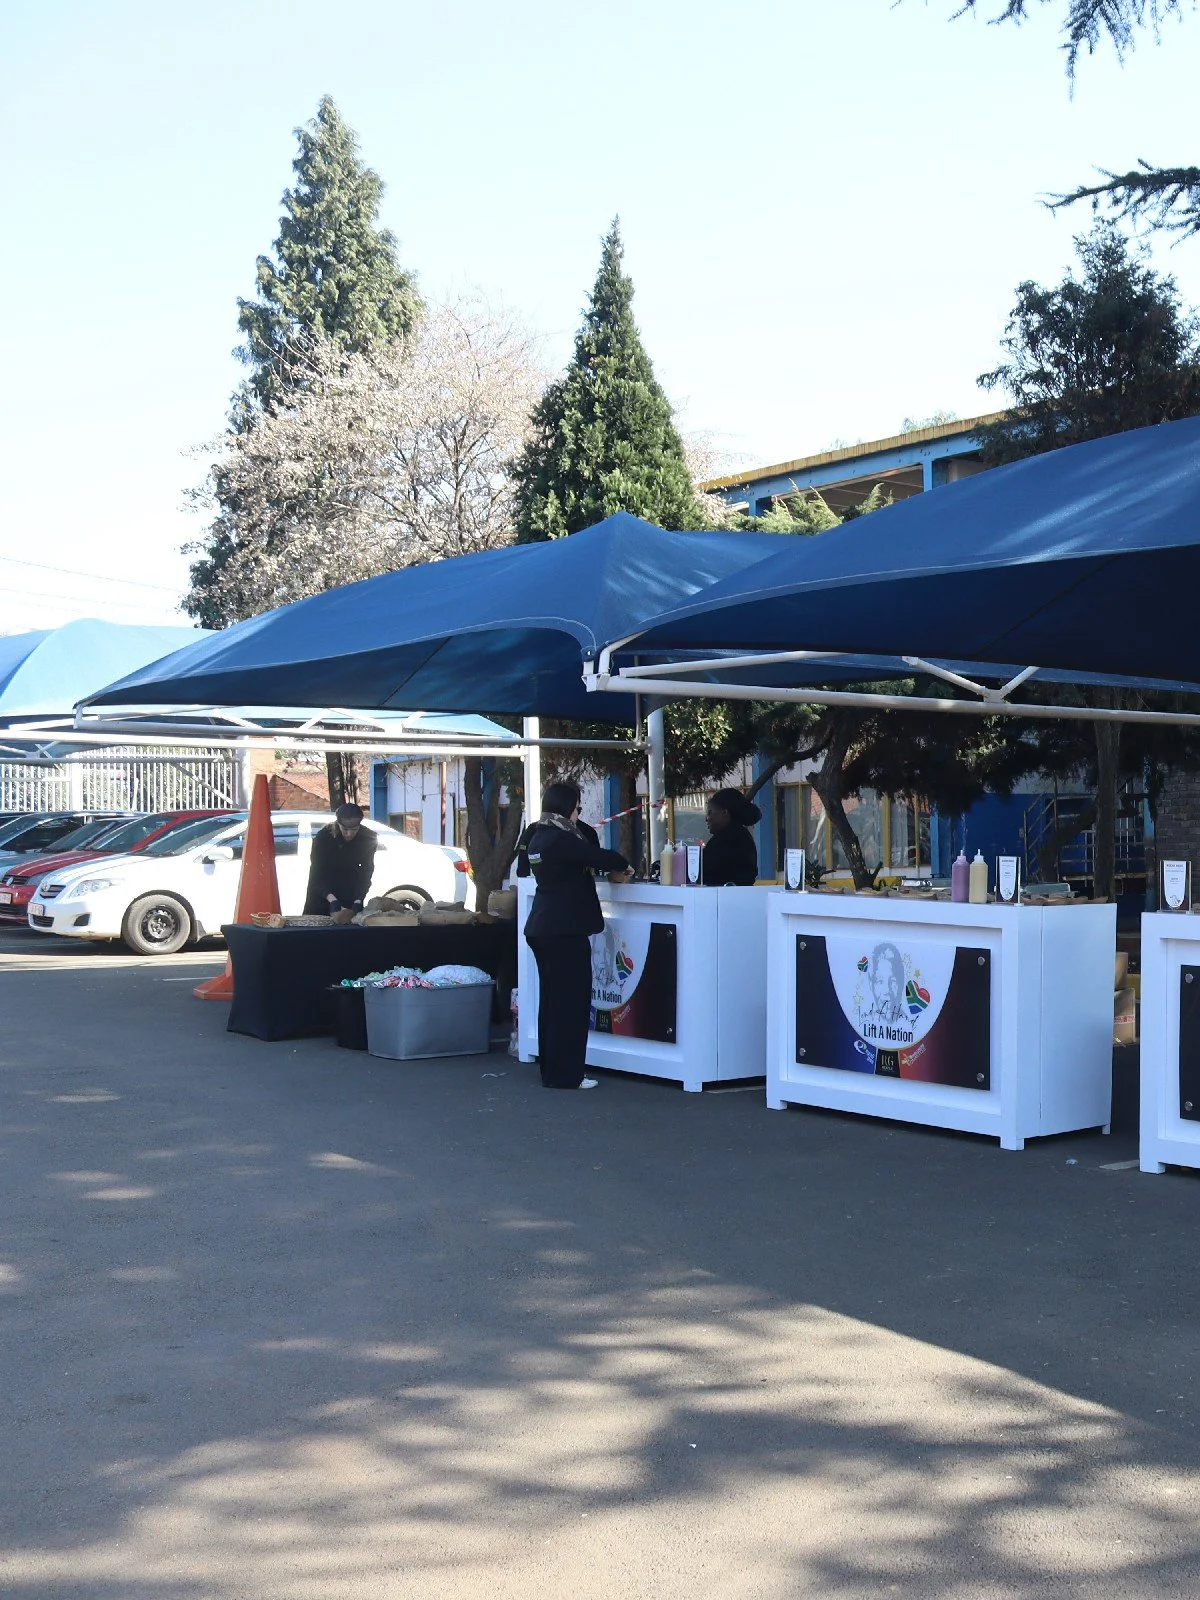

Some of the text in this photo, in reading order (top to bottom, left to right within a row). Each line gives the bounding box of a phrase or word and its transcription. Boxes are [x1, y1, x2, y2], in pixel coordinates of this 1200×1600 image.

[602, 990, 621, 1003] Nation
[864, 1024, 913, 1042] Lift A Nation
